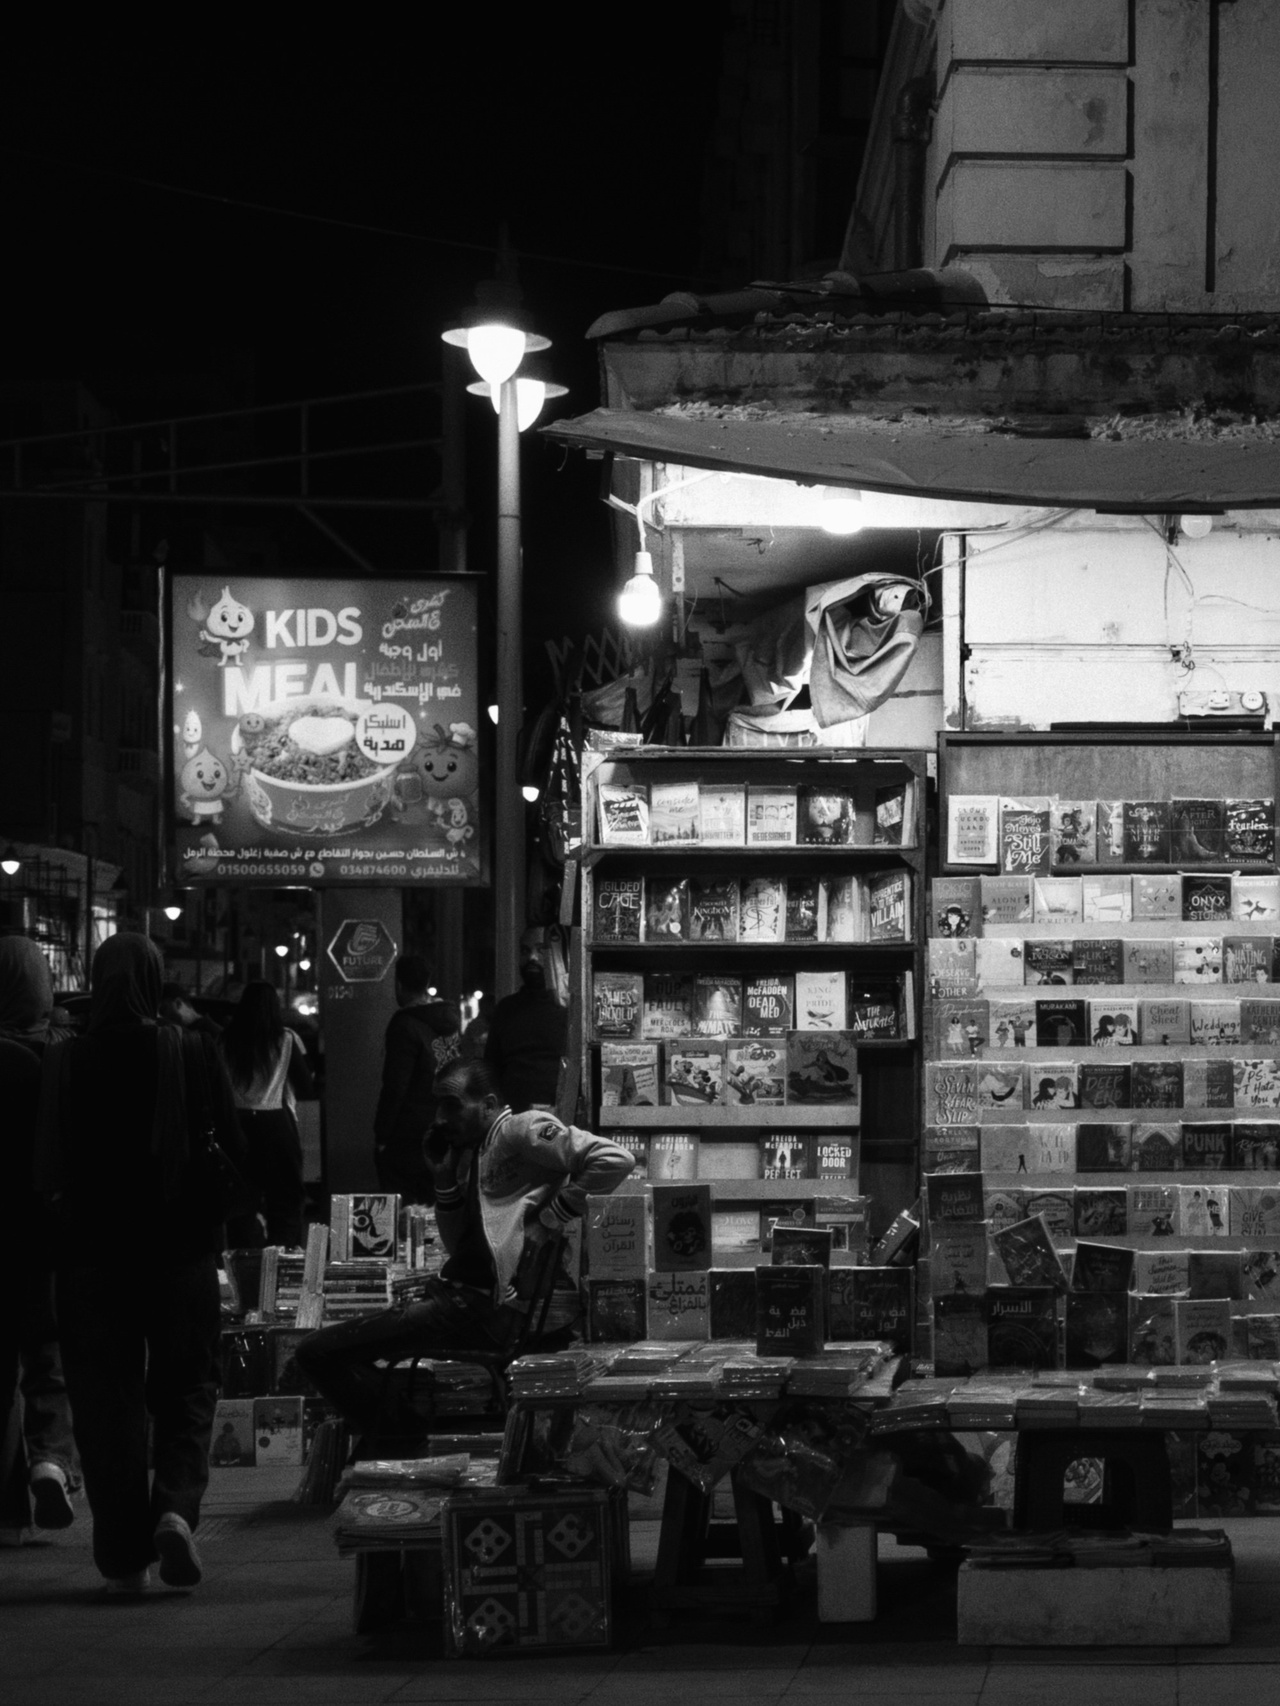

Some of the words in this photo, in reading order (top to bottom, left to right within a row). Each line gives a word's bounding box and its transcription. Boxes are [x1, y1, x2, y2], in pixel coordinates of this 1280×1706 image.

[266, 606, 363, 649] KIDS
[379, 643, 413, 661] وجبة
[417, 639, 442, 661] أول
[224, 662, 373, 716] MEAL
[363, 681, 434, 706] الإسكندرية
[436, 682, 462, 700] في
[363, 736, 406, 757] هدية
[1018, 814, 1042, 827] Jojo
[1179, 809, 1216, 820] AFTER
[960, 824, 984, 832] LAND
[1004, 822, 1042, 835] Moyes
[1227, 818, 1269, 833] Fearless
[752, 831, 791, 841] REDESIGNED
[1005, 833, 1043, 853] Still
[183, 848, 207, 862] الرمل
[207, 848, 235, 861] محطة
[236, 848, 262, 863] زغلول
[263, 848, 289, 862] صفية
[290, 847, 303, 860] ش
[304, 850, 316, 863] مع
[317, 848, 350, 862] التقاطع
[351, 849, 375, 863] بجوار
[376, 849, 405, 862] حسين
[406, 848, 445, 860] السلطان
[1010, 849, 1042, 865] Me
[217, 863, 306, 876] 01500655059
[340, 864, 407, 876] 034874600
[604, 881, 641, 892] GILDED
[599, 892, 640, 909] CAGE
[991, 896, 1023, 905] ALONE
[1191, 894, 1226, 907] ONYX
[871, 899, 905, 927] VILLAIN
[1190, 910, 1228, 920] STORM
[1075, 940, 1119, 949] NOTHING
[1232, 949, 1267, 965] HATING
[1087, 963, 1108, 973] THE
[756, 978, 780, 987] FREIDA
[747, 986, 788, 997] McFADDEN
[807, 987, 833, 995] KING
[937, 987, 969, 998] OTHER
[600, 991, 633, 1006] GAMES
[748, 996, 776, 1009] DEAD
[806, 1000, 835, 1008] PRIDE
[759, 1006, 781, 1019] MED
[866, 1005, 882, 1017] THE
[1039, 1003, 1078, 1011] MURAKAMI
[1149, 1004, 1181, 1016] Cheat
[1150, 1014, 1180, 1026] Sheet
[1248, 1069, 1267, 1082] PS:
[1085, 1075, 1124, 1092] DEEP
[1137, 1084, 1179, 1094] KNIGHT
[1243, 1084, 1250, 1095] I
[1253, 1082, 1272, 1093] Hate
[1093, 1088, 1123, 1107] END
[1250, 1094, 1268, 1106] You
[661, 1135, 687, 1144] FREIDA
[770, 1135, 798, 1144] FREIDA
[1185, 1134, 1226, 1151] PUNK
[655, 1142, 696, 1152] McFADDEN
[764, 1142, 804, 1151] McFADDEN
[817, 1146, 853, 1158] LOCKED
[821, 1157, 847, 1169] DOOR
[1204, 1153, 1224, 1169] 57
[601, 1215, 636, 1229] رسائل
[1242, 1211, 1265, 1222] GIVE
[602, 1239, 636, 1254] القرآن
[787, 1318, 807, 1330] ذيل
[764, 1326, 791, 1338] القط
